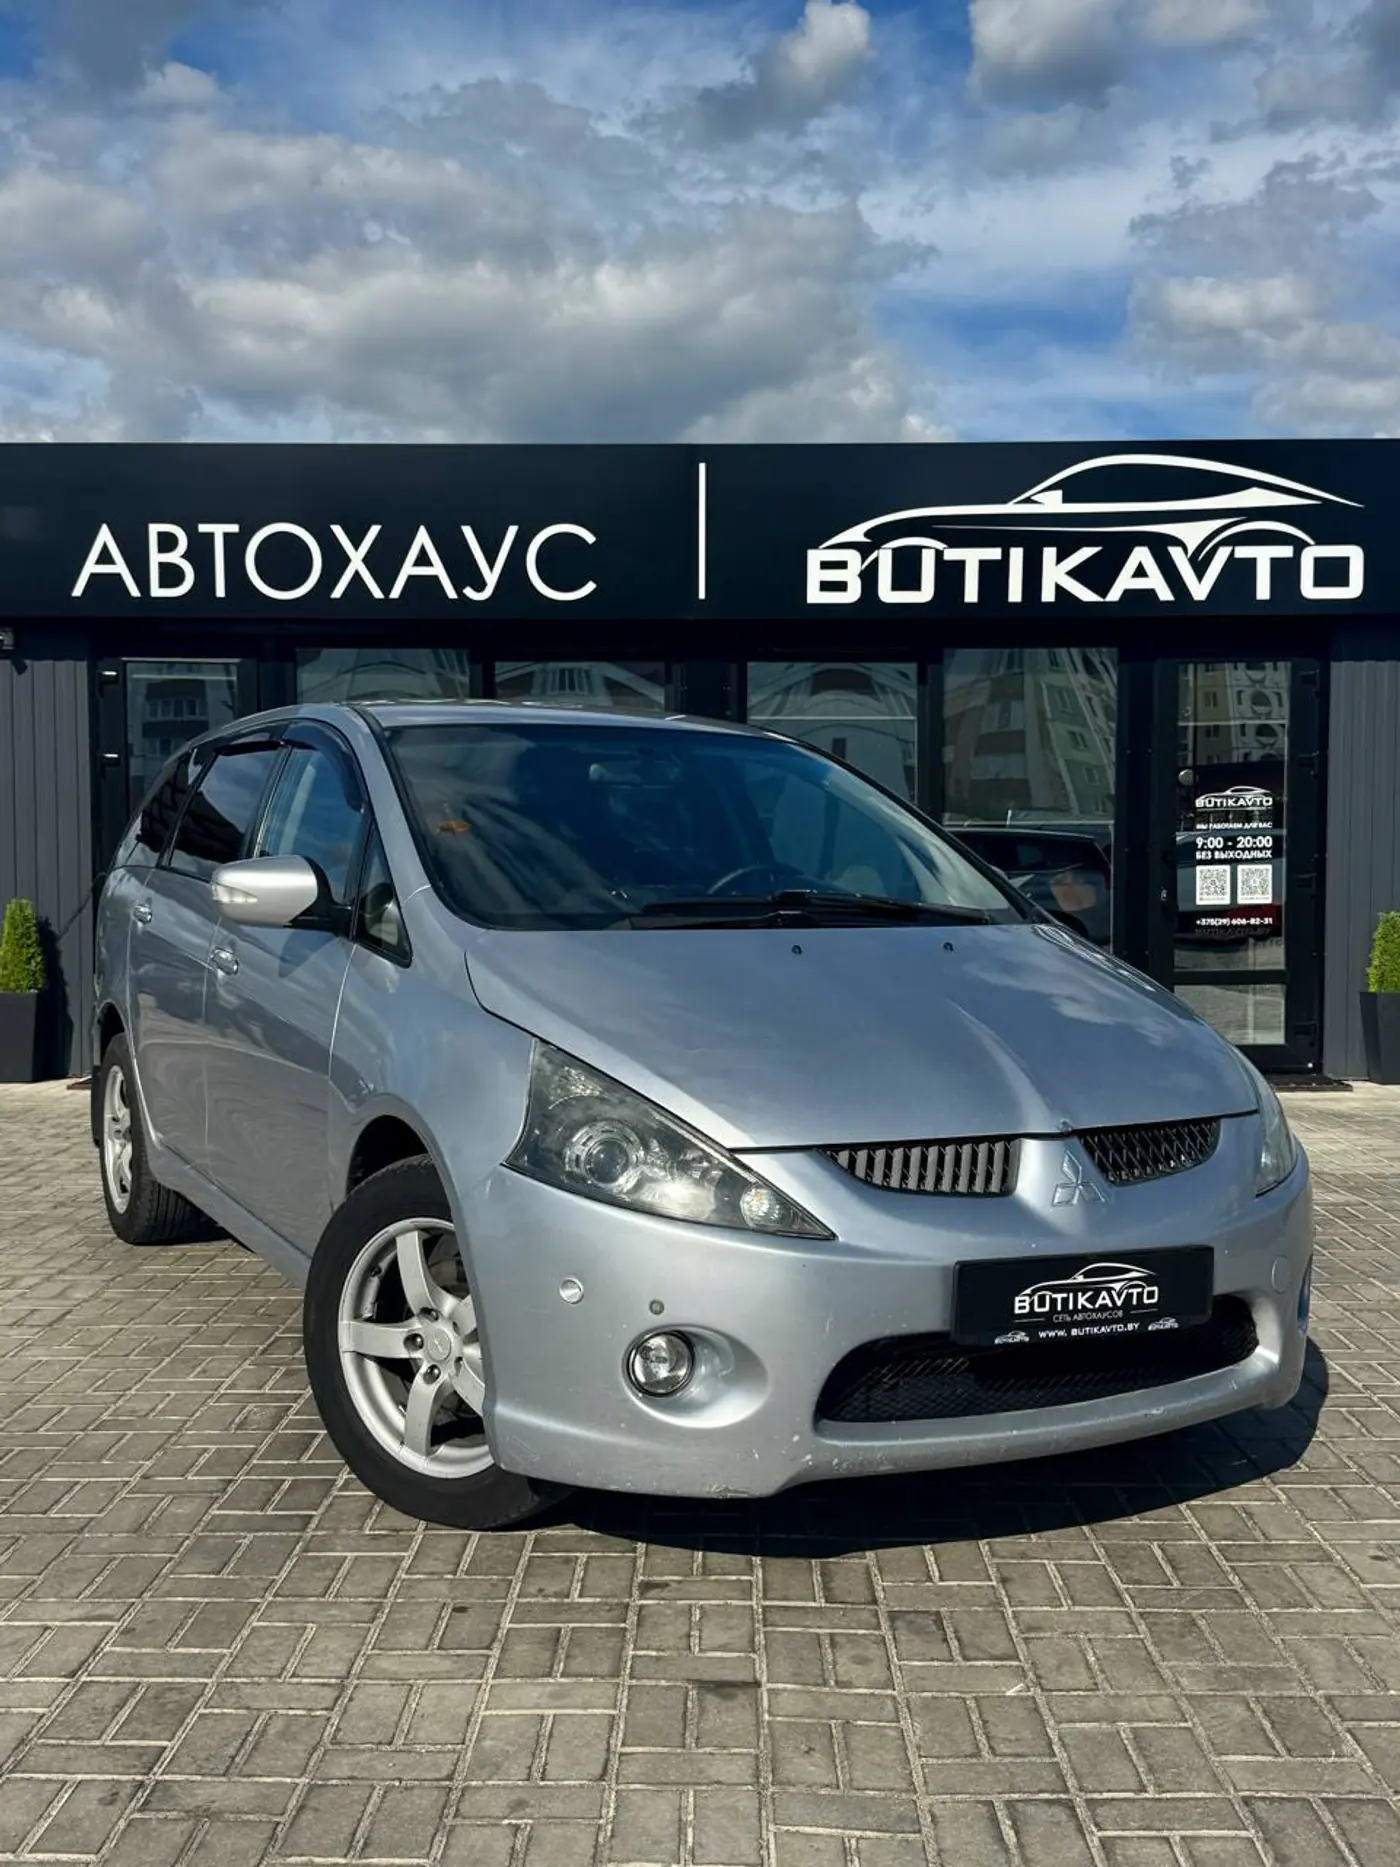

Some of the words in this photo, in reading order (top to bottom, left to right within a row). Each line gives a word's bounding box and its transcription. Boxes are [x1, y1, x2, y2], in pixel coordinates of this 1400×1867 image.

[71, 522, 597, 601] АВТОХАУС
[806, 544, 1366, 604] BUTIKAVTO
[1195, 797, 1273, 808] BUTIKAVTO
[1196, 837, 1224, 849] 9:00
[1236, 836, 1273, 848] 20:00
[1196, 851, 1212, 860] БЕЗ
[1214, 850, 1272, 859] ВЫХОДНЫХ
[1014, 1286, 1159, 1314] BUTIKAVTO
[1052, 1314, 1071, 1323] СЕТЬ
[1072, 1310, 1124, 1321] АВТОХАУСОВ
[1071, 1322, 1140, 1336] BUTIKAVTO.BY
